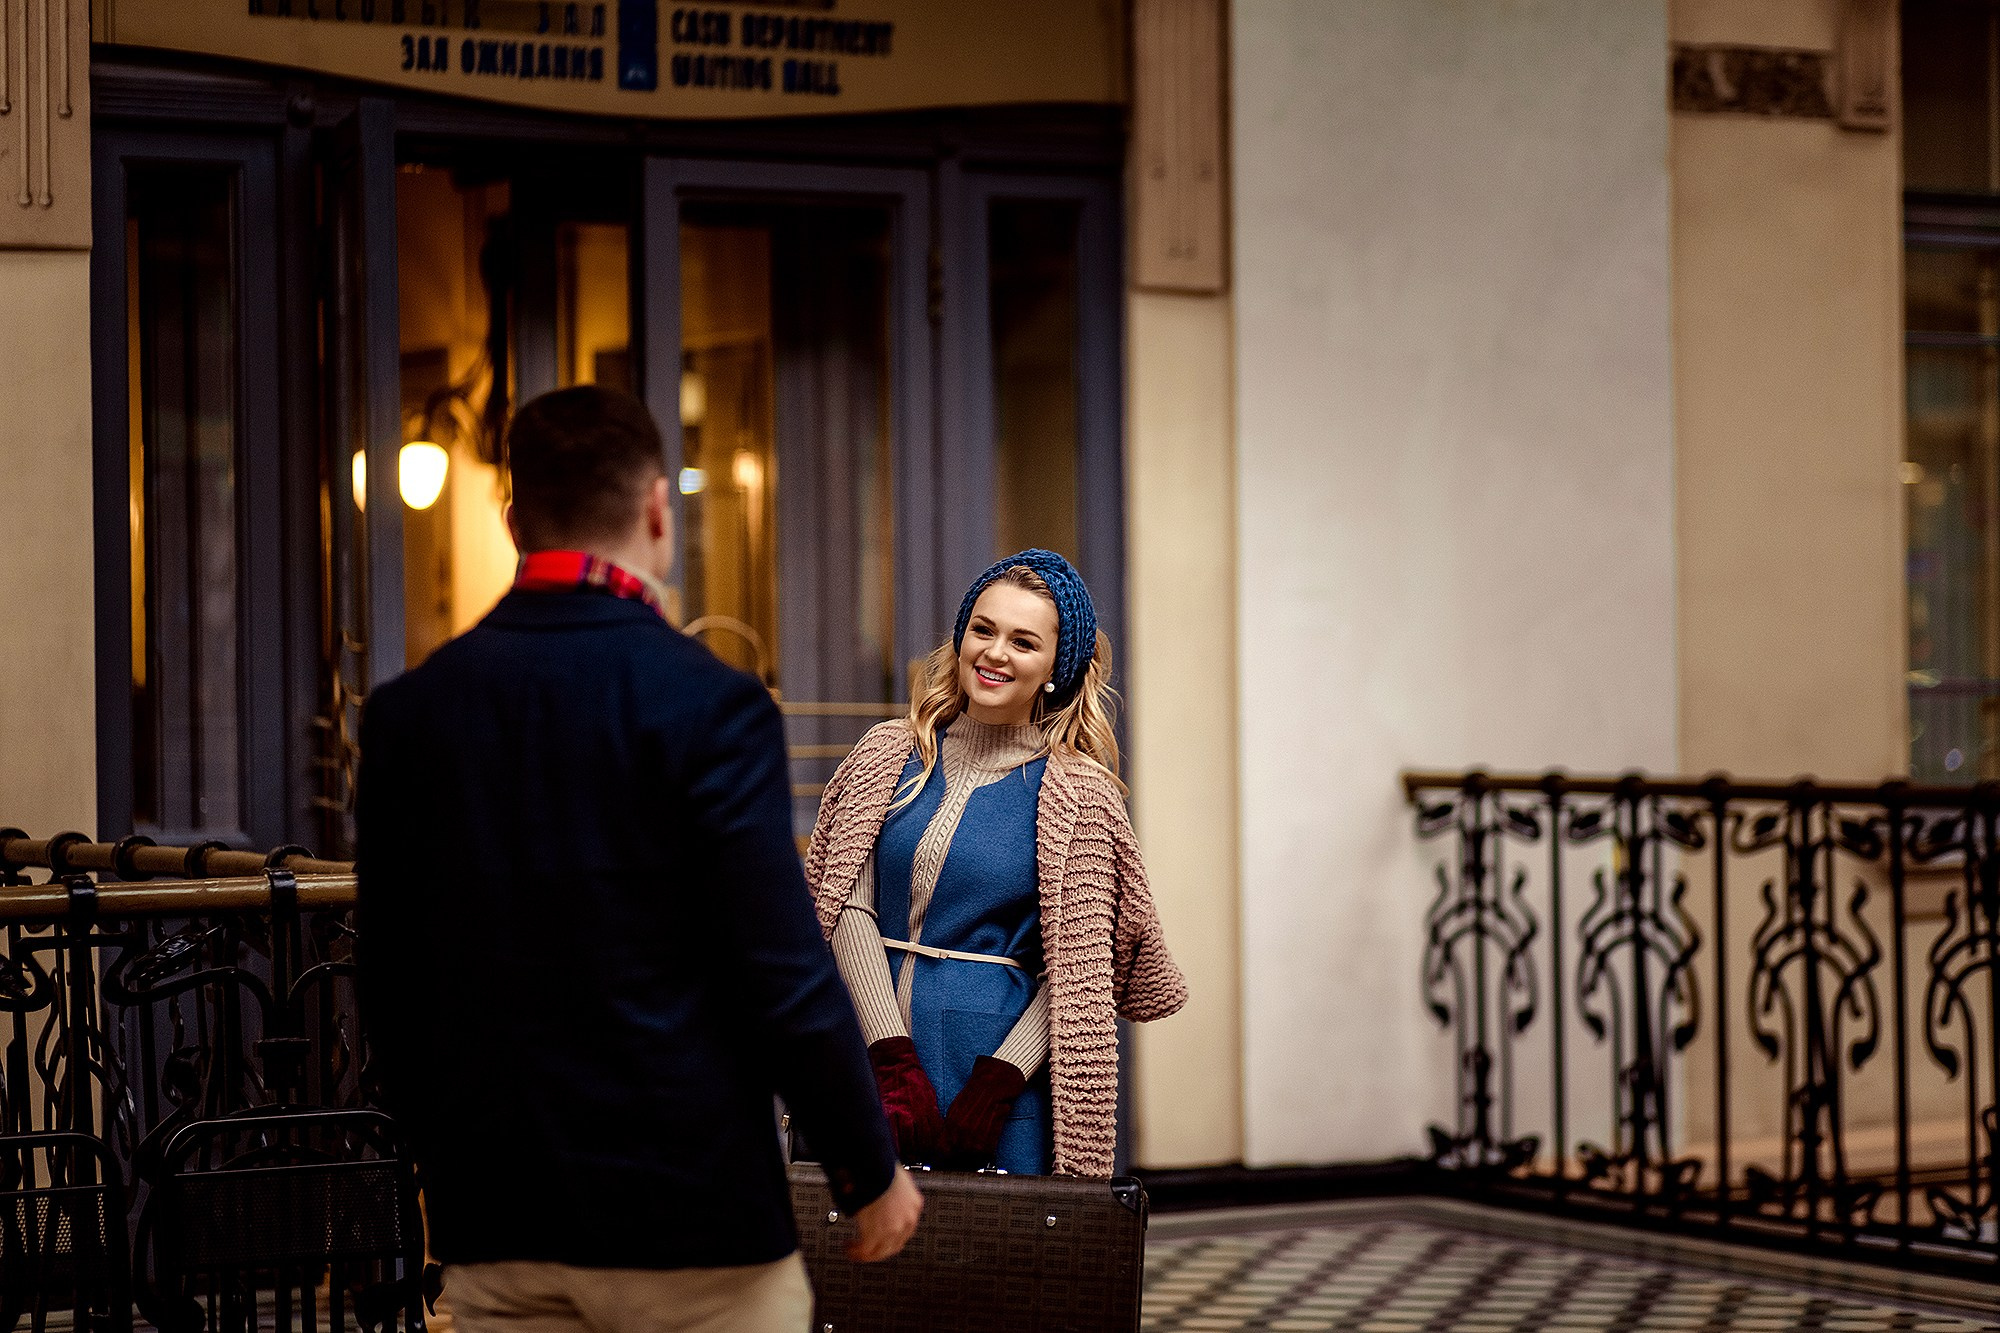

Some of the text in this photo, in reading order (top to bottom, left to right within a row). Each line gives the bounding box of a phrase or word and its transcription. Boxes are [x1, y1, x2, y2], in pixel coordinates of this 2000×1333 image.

[537, 1, 605, 36] ЗАЛ
[672, 9, 892, 55] CASH DEPARTMENT
[401, 34, 604, 80] ЗАЛ ОЖИДАНИЯ
[672, 54, 840, 95] WAITING HALL
